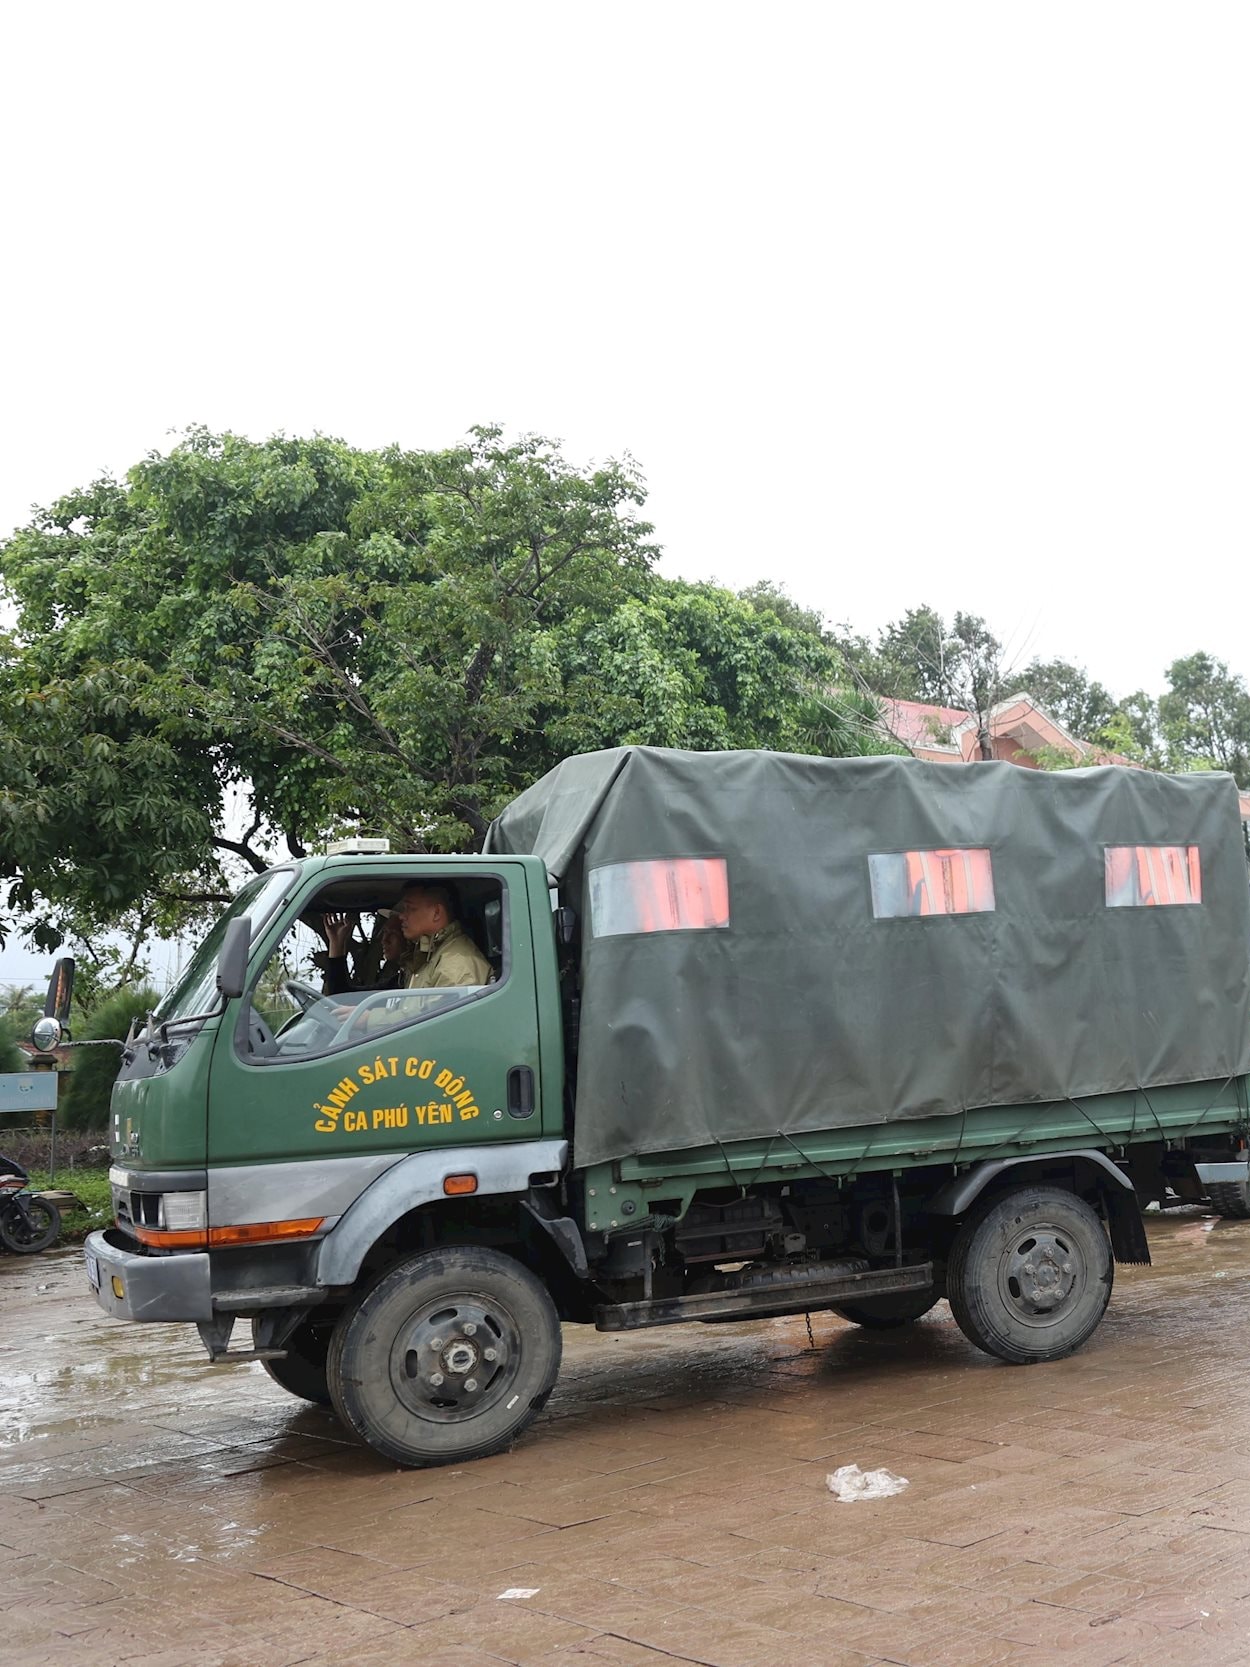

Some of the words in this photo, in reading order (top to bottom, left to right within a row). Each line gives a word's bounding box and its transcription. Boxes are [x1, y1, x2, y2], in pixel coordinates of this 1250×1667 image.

[313, 1077, 360, 1133] CẢNH
[357, 1055, 399, 1085] SÁT
[405, 1056, 436, 1080] CƠ
[433, 1068, 480, 1121] ĐỘNG
[343, 1111, 368, 1132] CA
[372, 1103, 409, 1129] PHÚ
[415, 1101, 453, 1125] YÊN
